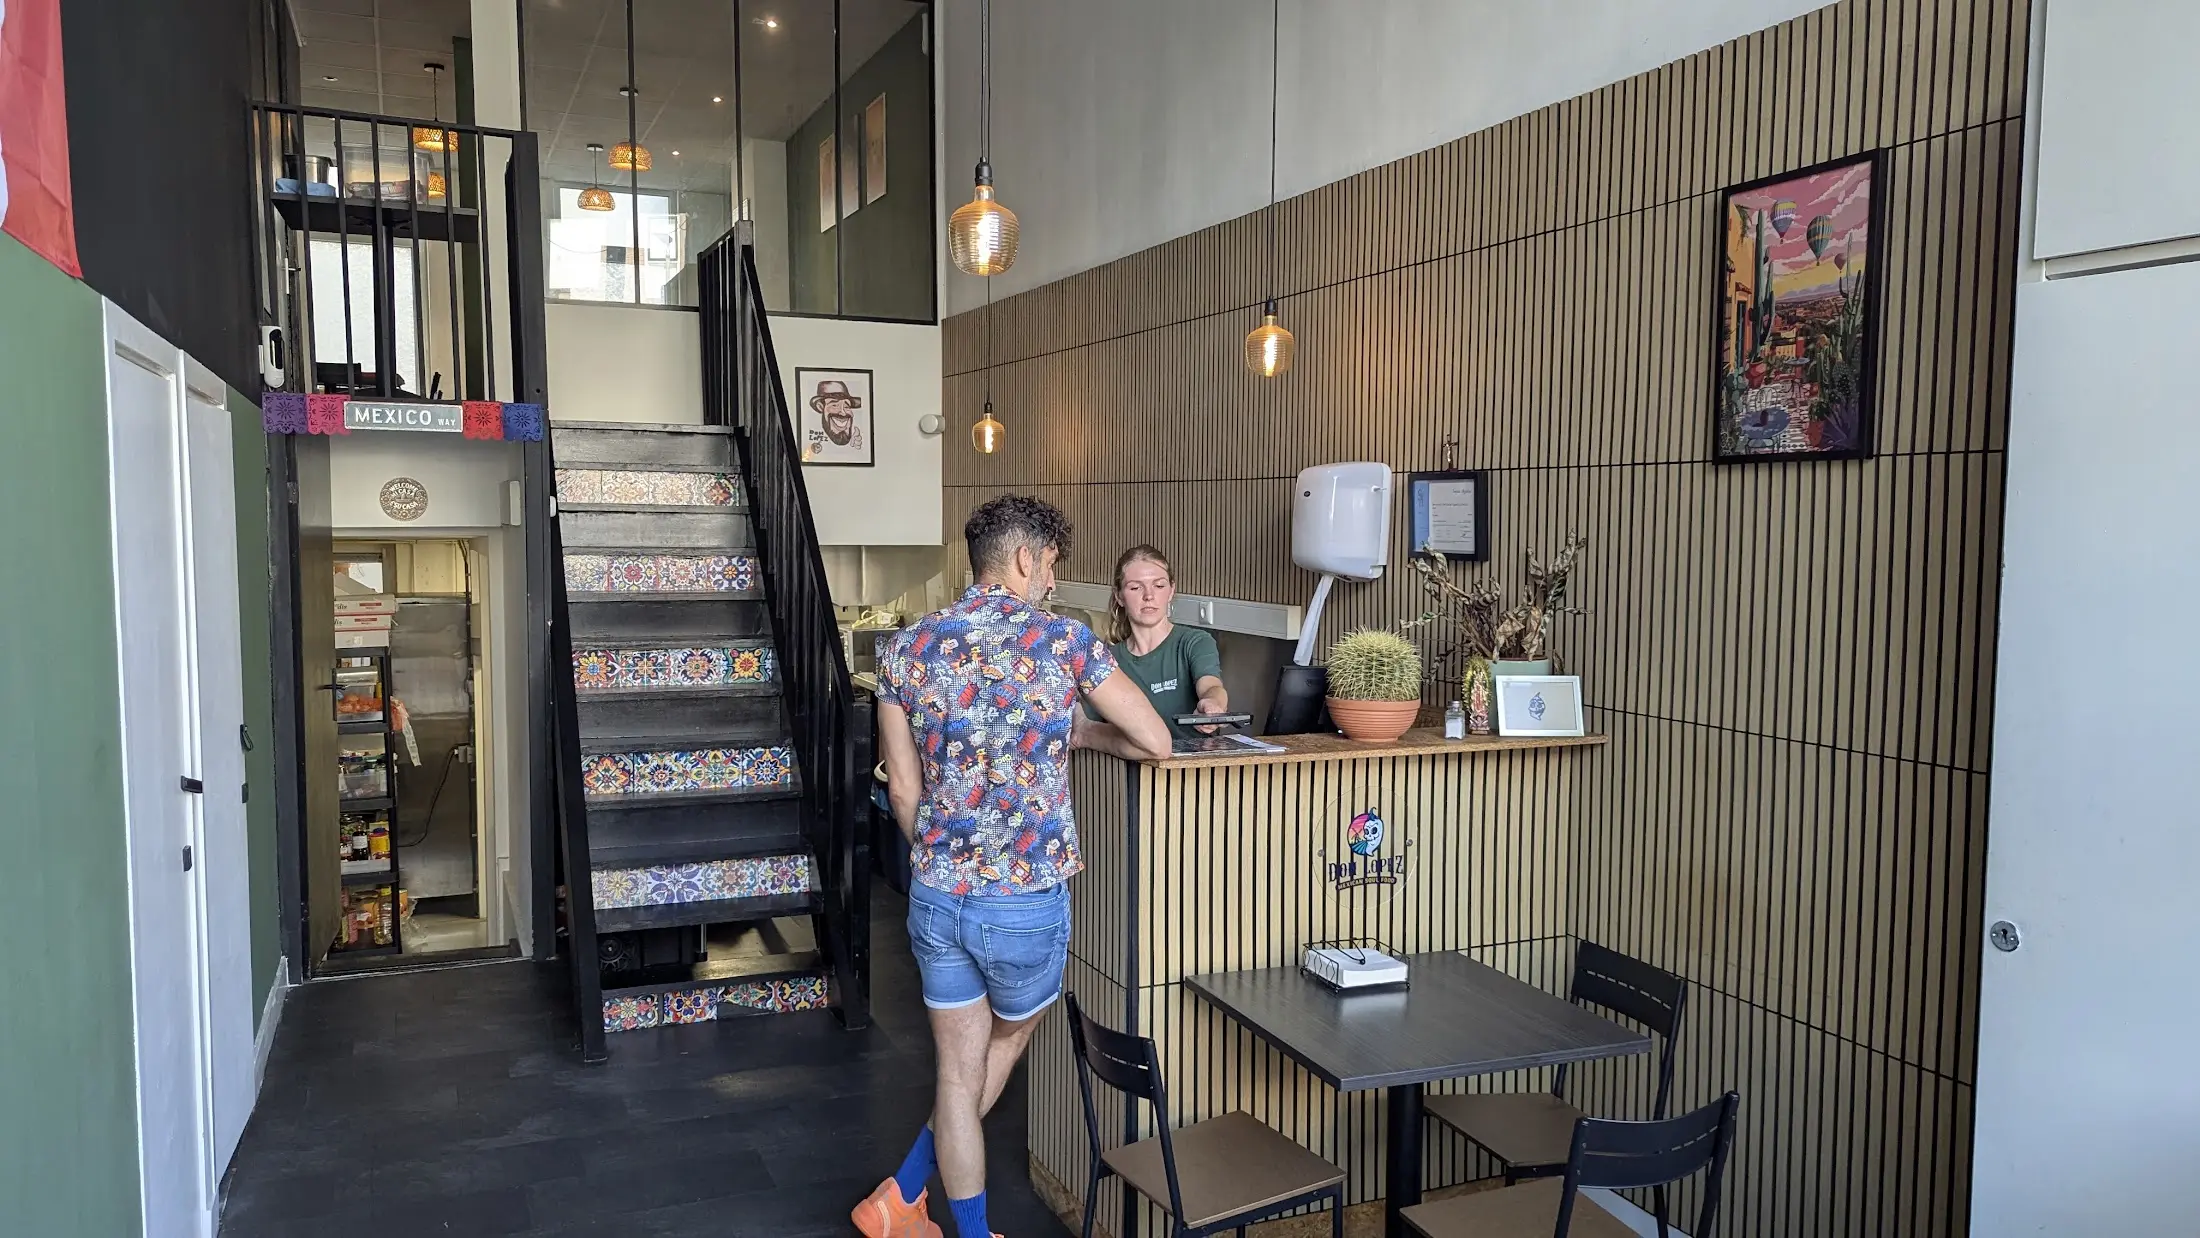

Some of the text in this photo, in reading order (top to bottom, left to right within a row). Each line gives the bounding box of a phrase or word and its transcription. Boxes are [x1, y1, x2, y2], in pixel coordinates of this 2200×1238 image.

[355, 407, 456, 426] MEXICO WAY
[389, 482, 419, 492] WELCOME
[1328, 855, 1404, 882] DON LOPEZ
[1337, 878, 1364, 890] MEXICAN
